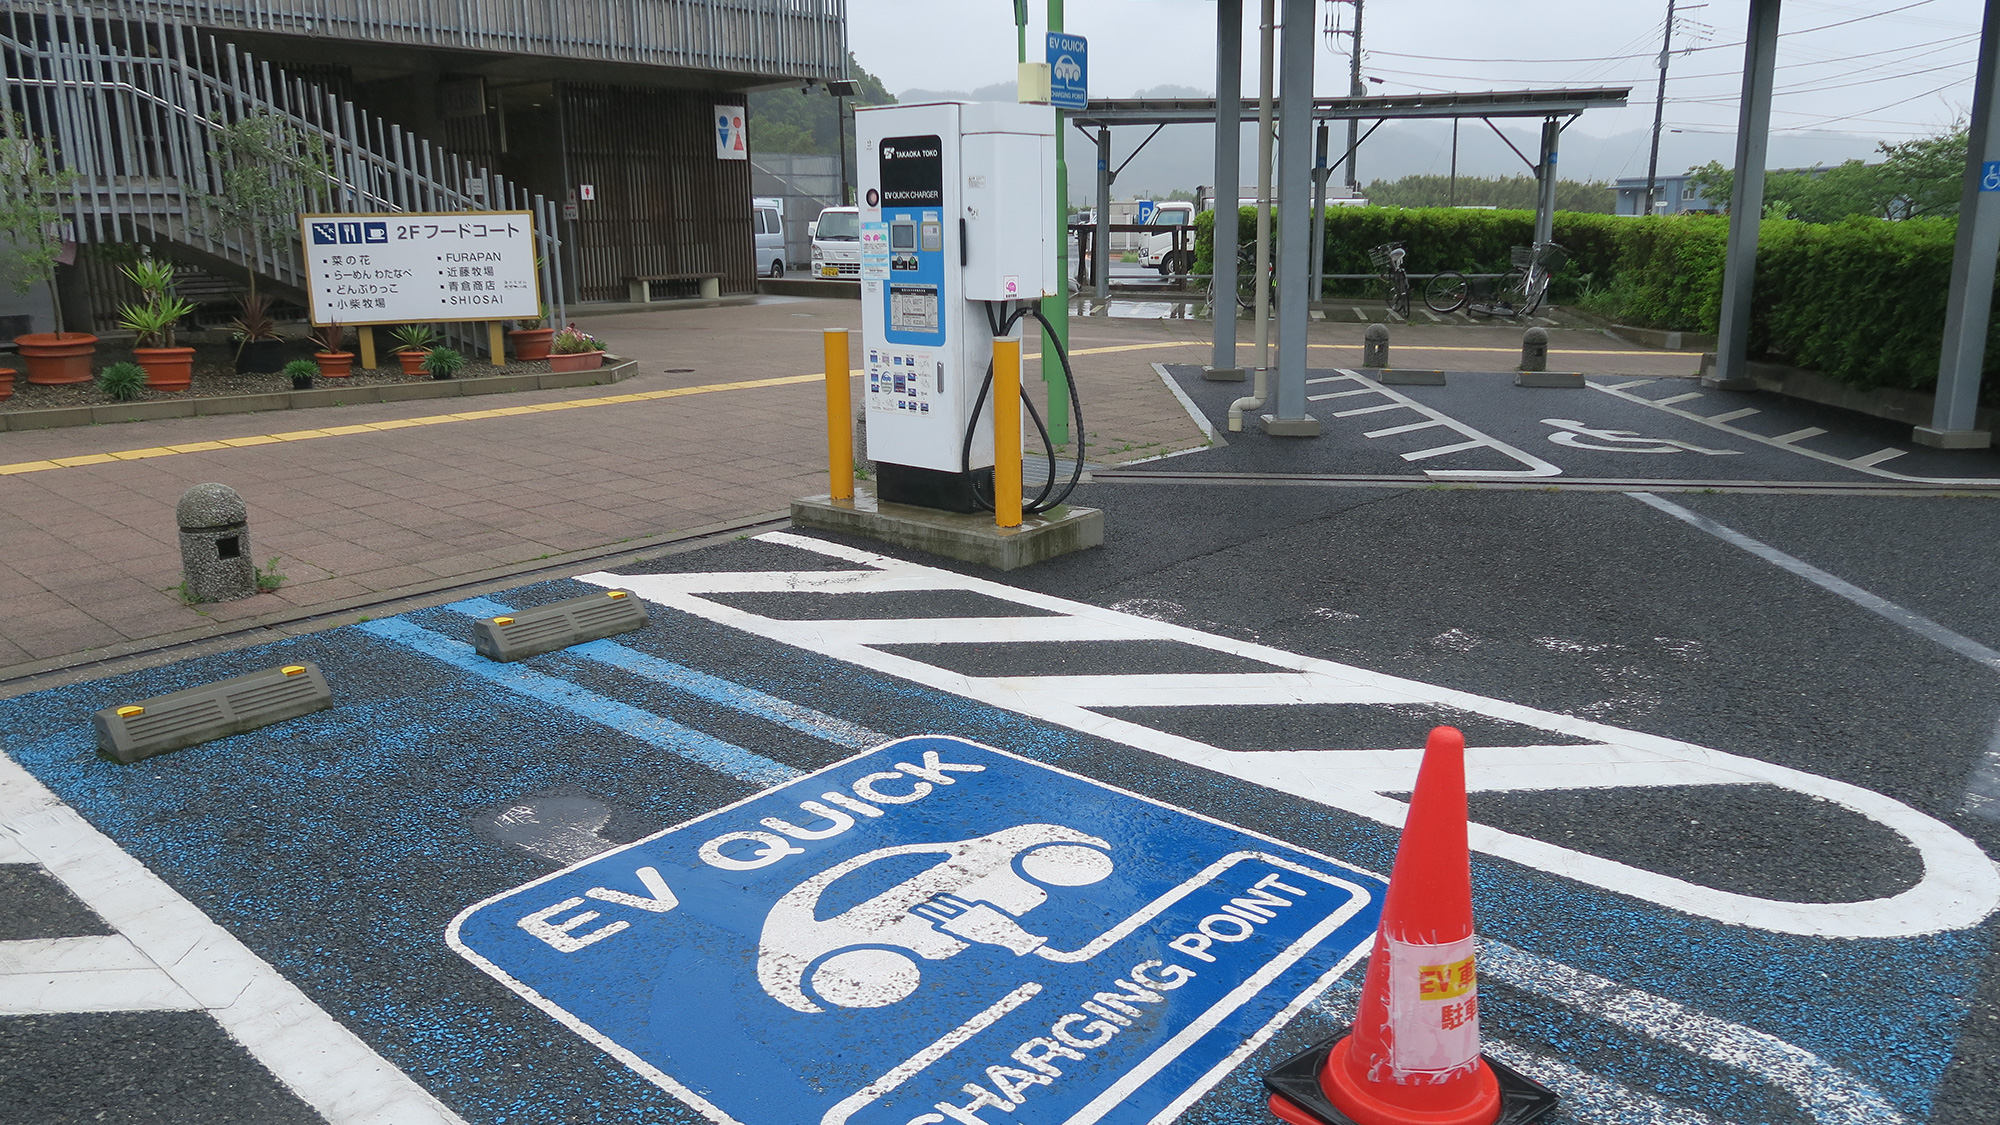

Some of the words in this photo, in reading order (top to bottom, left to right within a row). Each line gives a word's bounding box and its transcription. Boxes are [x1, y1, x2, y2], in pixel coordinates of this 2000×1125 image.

[1049, 37, 1060, 49] EV
[1061, 39, 1085, 53] QUICK
[922, 149, 938, 157] TOKO
[893, 191, 911, 199] QUICK
[911, 190, 939, 199] CHARGER
[1141, 207, 1151, 221] P
[332, 255, 371, 266] 菜の花
[446, 252, 502, 262] FURAPAN
[447, 266, 495, 278] 近藤牧場
[336, 284, 399, 295] どんぶりっこ
[448, 280, 496, 292] 青倉商店
[337, 298, 386, 310] 小柴牧場
[450, 295, 503, 305] SHIOSAI
[517, 865, 679, 953] EV
[698, 751, 987, 871] QUICK
[1420, 969, 1452, 994] EV
[904, 959, 1196, 1125] HARGING
[1168, 872, 1308, 963] POINT
[1441, 995, 1478, 1031] 駐車
